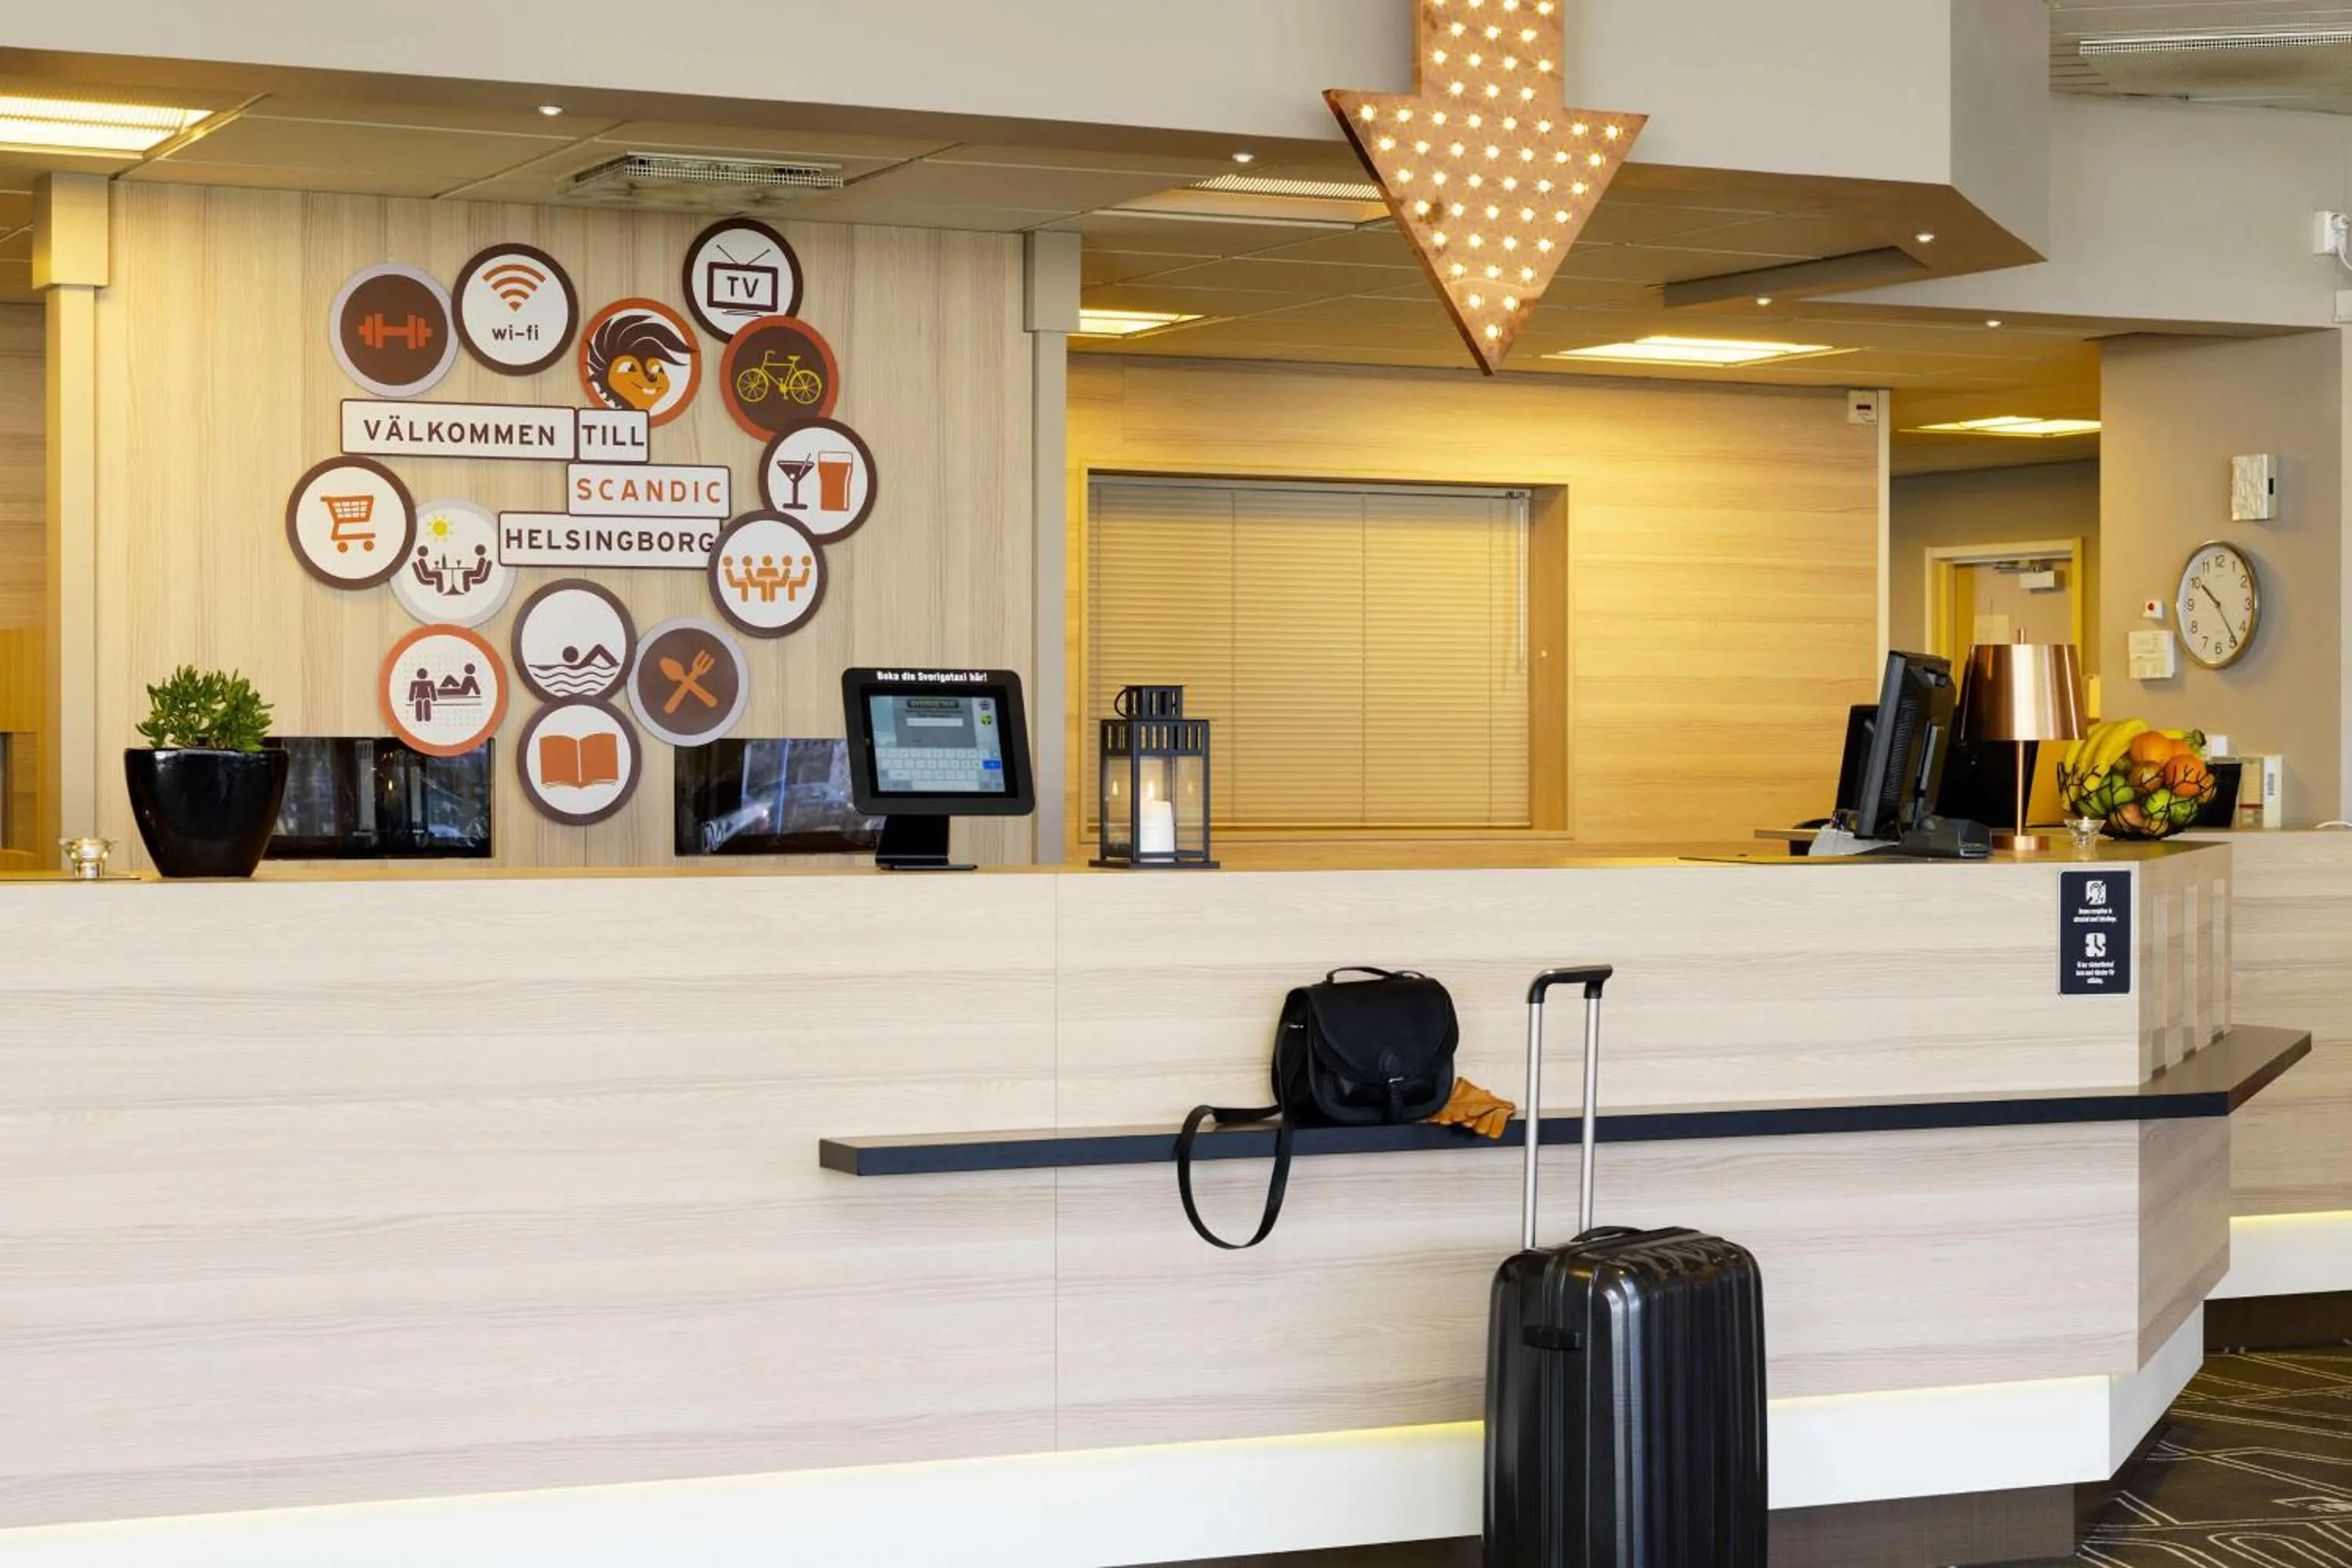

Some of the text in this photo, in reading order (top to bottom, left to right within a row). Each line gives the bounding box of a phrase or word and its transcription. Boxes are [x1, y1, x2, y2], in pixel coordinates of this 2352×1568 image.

[728, 275, 760, 299] TV
[492, 324, 539, 342] wi-fi
[363, 414, 646, 448] VÄLKOMMEN TILL
[576, 477, 721, 504] SCANDIC
[505, 527, 714, 553] HELSINGBORG
[2201, 561, 2211, 573] 11
[2215, 554, 2226, 568] 12
[2190, 576, 2201, 590] 10
[2240, 575, 2248, 588] 2
[2186, 598, 2195, 612] 9
[2245, 597, 2252, 611] 3
[2190, 620, 2199, 634] 8
[2238, 620, 2247, 633] 4
[2201, 636, 2209, 650] 7
[2214, 641, 2223, 655] 6
